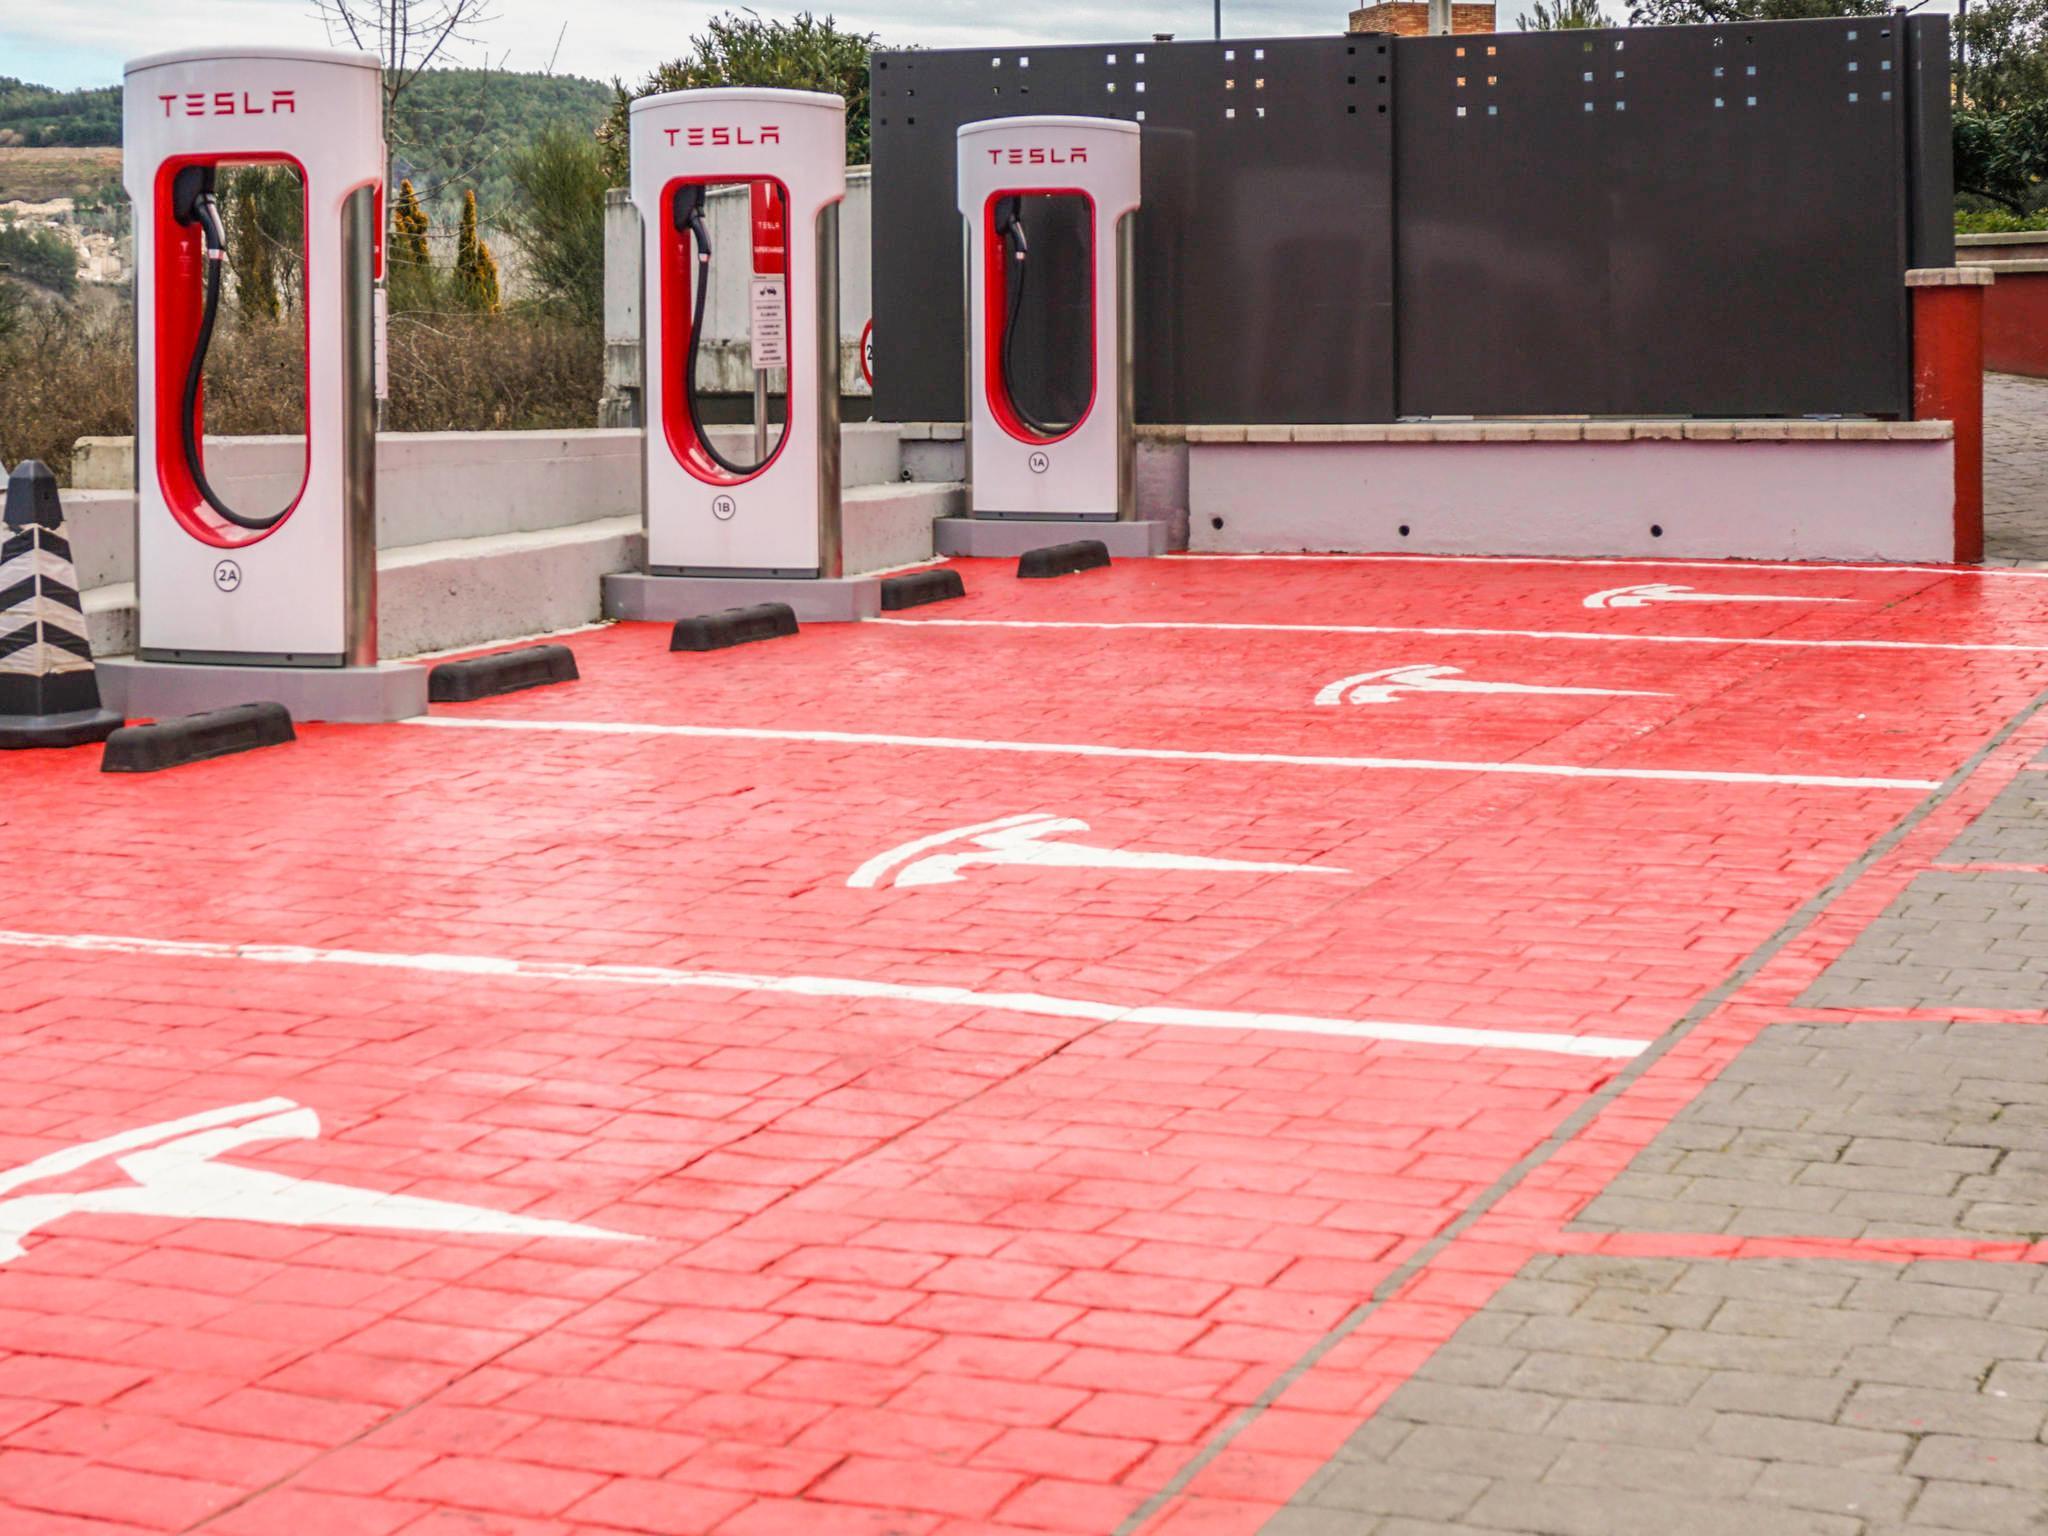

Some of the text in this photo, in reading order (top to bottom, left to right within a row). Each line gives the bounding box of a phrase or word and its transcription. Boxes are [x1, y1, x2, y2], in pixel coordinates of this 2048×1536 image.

[158, 91, 295, 117] TESLA
[663, 126, 780, 148] TESLA
[988, 147, 1088, 165] TESLA
[1033, 458, 1045, 467] 1A
[717, 502, 730, 512] 1B
[218, 569, 238, 582] 2A
